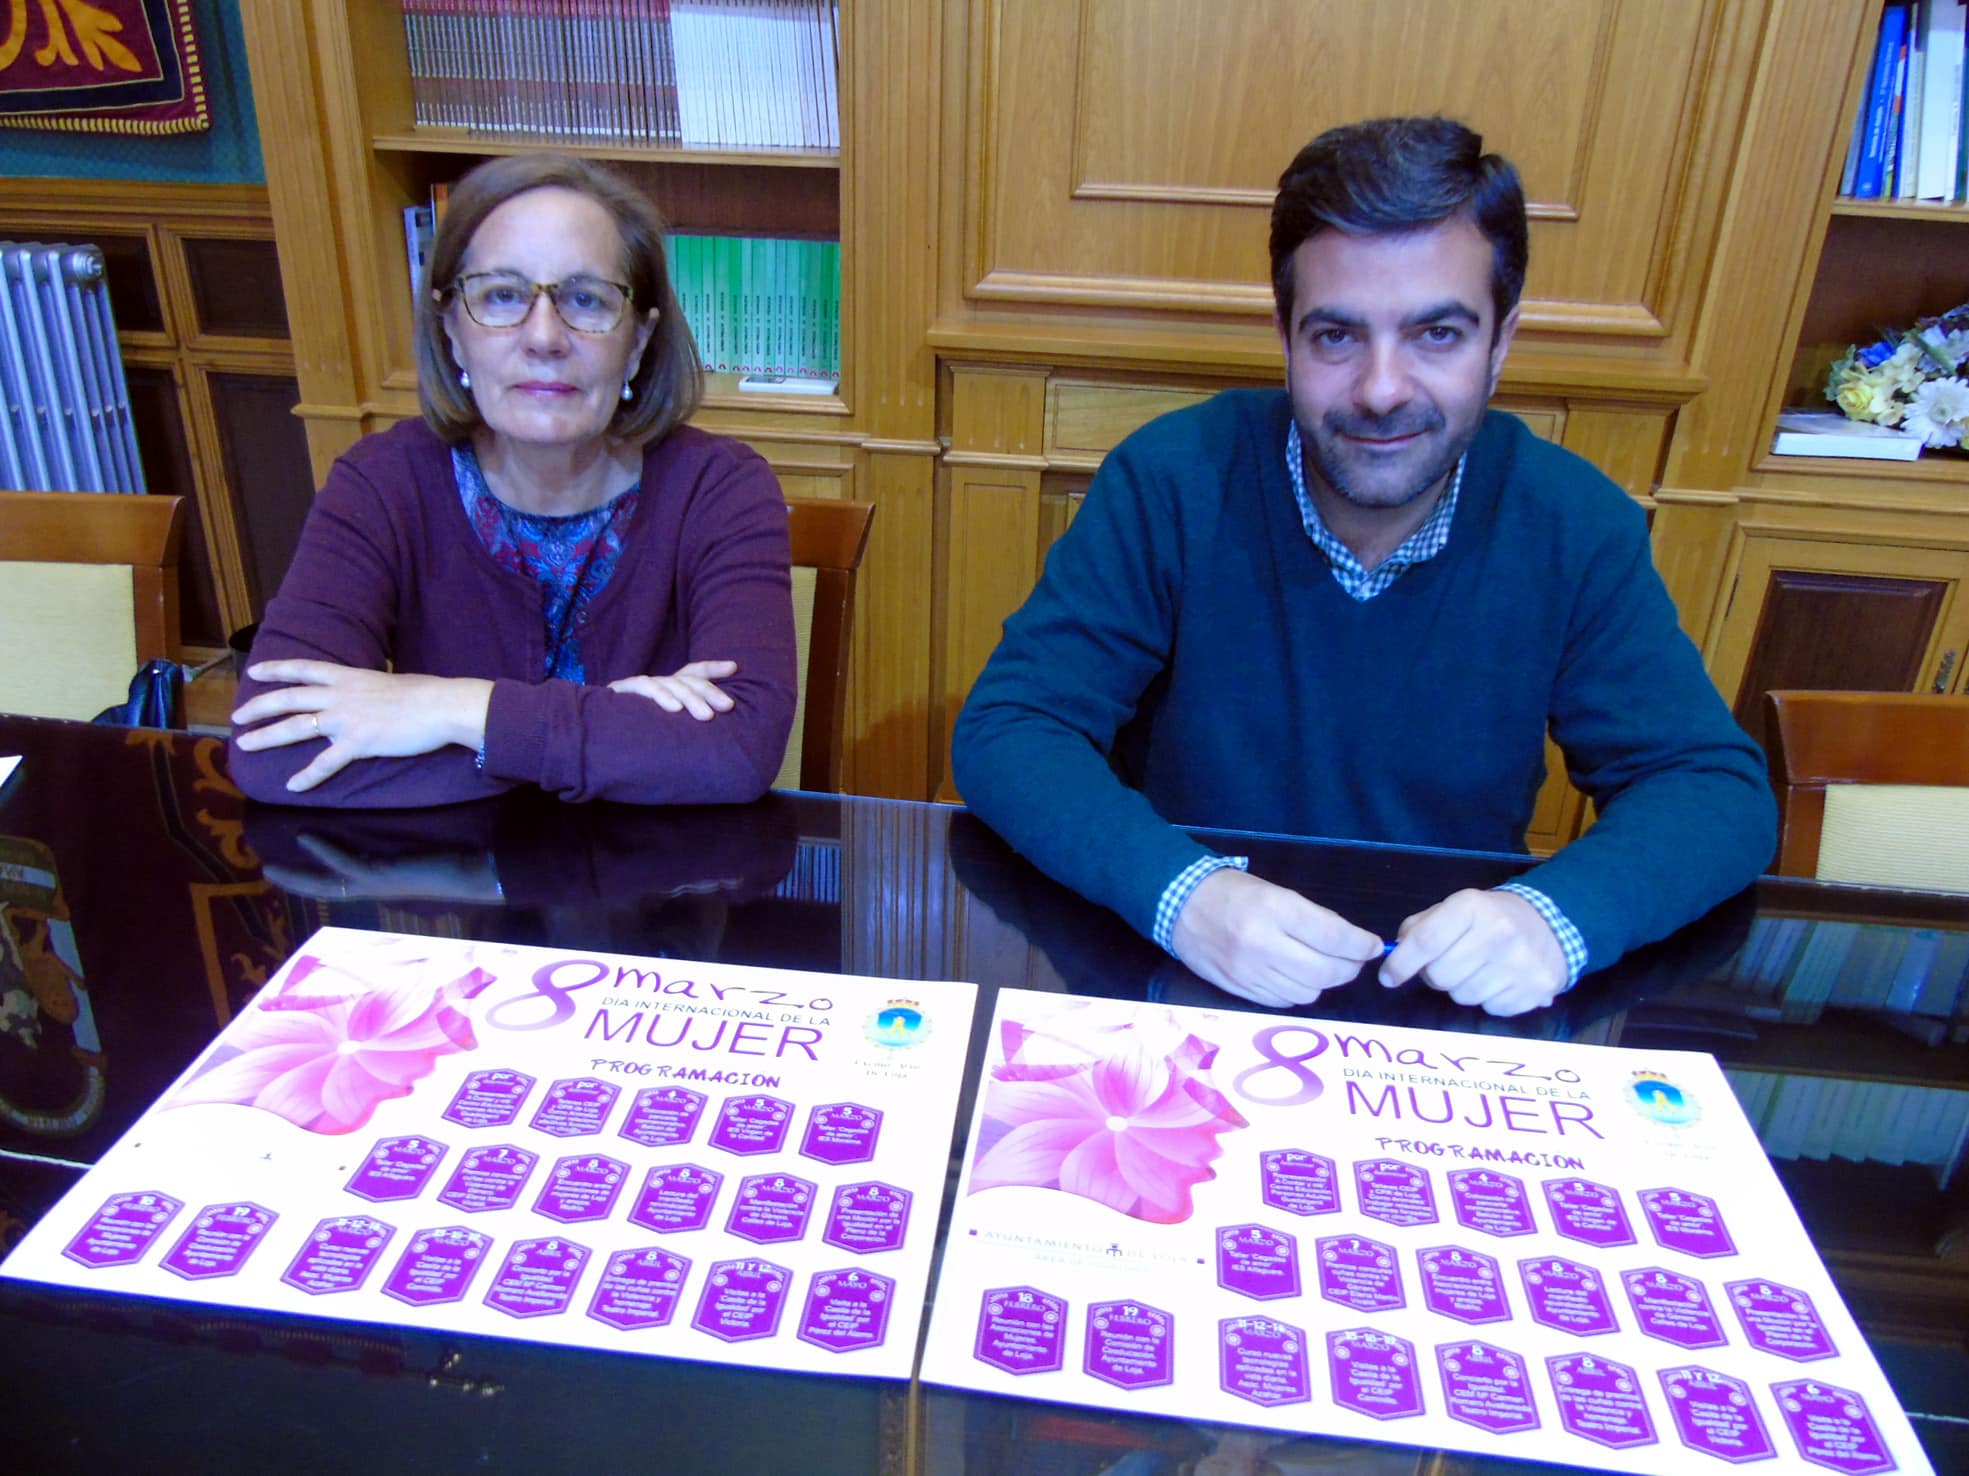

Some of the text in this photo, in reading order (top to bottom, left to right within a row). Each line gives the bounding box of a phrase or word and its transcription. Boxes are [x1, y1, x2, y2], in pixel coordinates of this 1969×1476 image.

[614, 966, 834, 1012] marzo
[486, 959, 609, 1031] 8
[635, 998, 775, 1021] INTERNACIONAL
[780, 1013, 802, 1023] DE
[809, 1015, 830, 1026] LA
[584, 1009, 824, 1060] MUJER
[1335, 1033, 1581, 1083] marzo
[1233, 1025, 1328, 1106] 8
[591, 1059, 781, 1087] PROGRAMACION
[1378, 1071, 1528, 1094] INTERNACIONAL
[1536, 1086, 1560, 1098] DE
[1569, 1089, 1591, 1100] LA
[1345, 1081, 1605, 1139] MUJER
[497, 1149, 509, 1157] 7
[1376, 1137, 1584, 1170] PROGRAMACION
[587, 1159, 600, 1167] 8
[679, 1168, 691, 1177] 8
[774, 1177, 785, 1186] 8
[868, 1186, 880, 1195] 8
[1250, 1229, 1260, 1238] 5
[546, 1241, 559, 1249] 8
[1350, 1240, 1361, 1249] 7
[644, 1252, 658, 1260] 8
[1450, 1251, 1462, 1260] 8
[1550, 1262, 1562, 1271] 8
[847, 1271, 859, 1280] 6
[837, 1279, 866, 1288] MAYO
[1018, 1292, 1033, 1303] 18
[1123, 1306, 1138, 1316] 19
